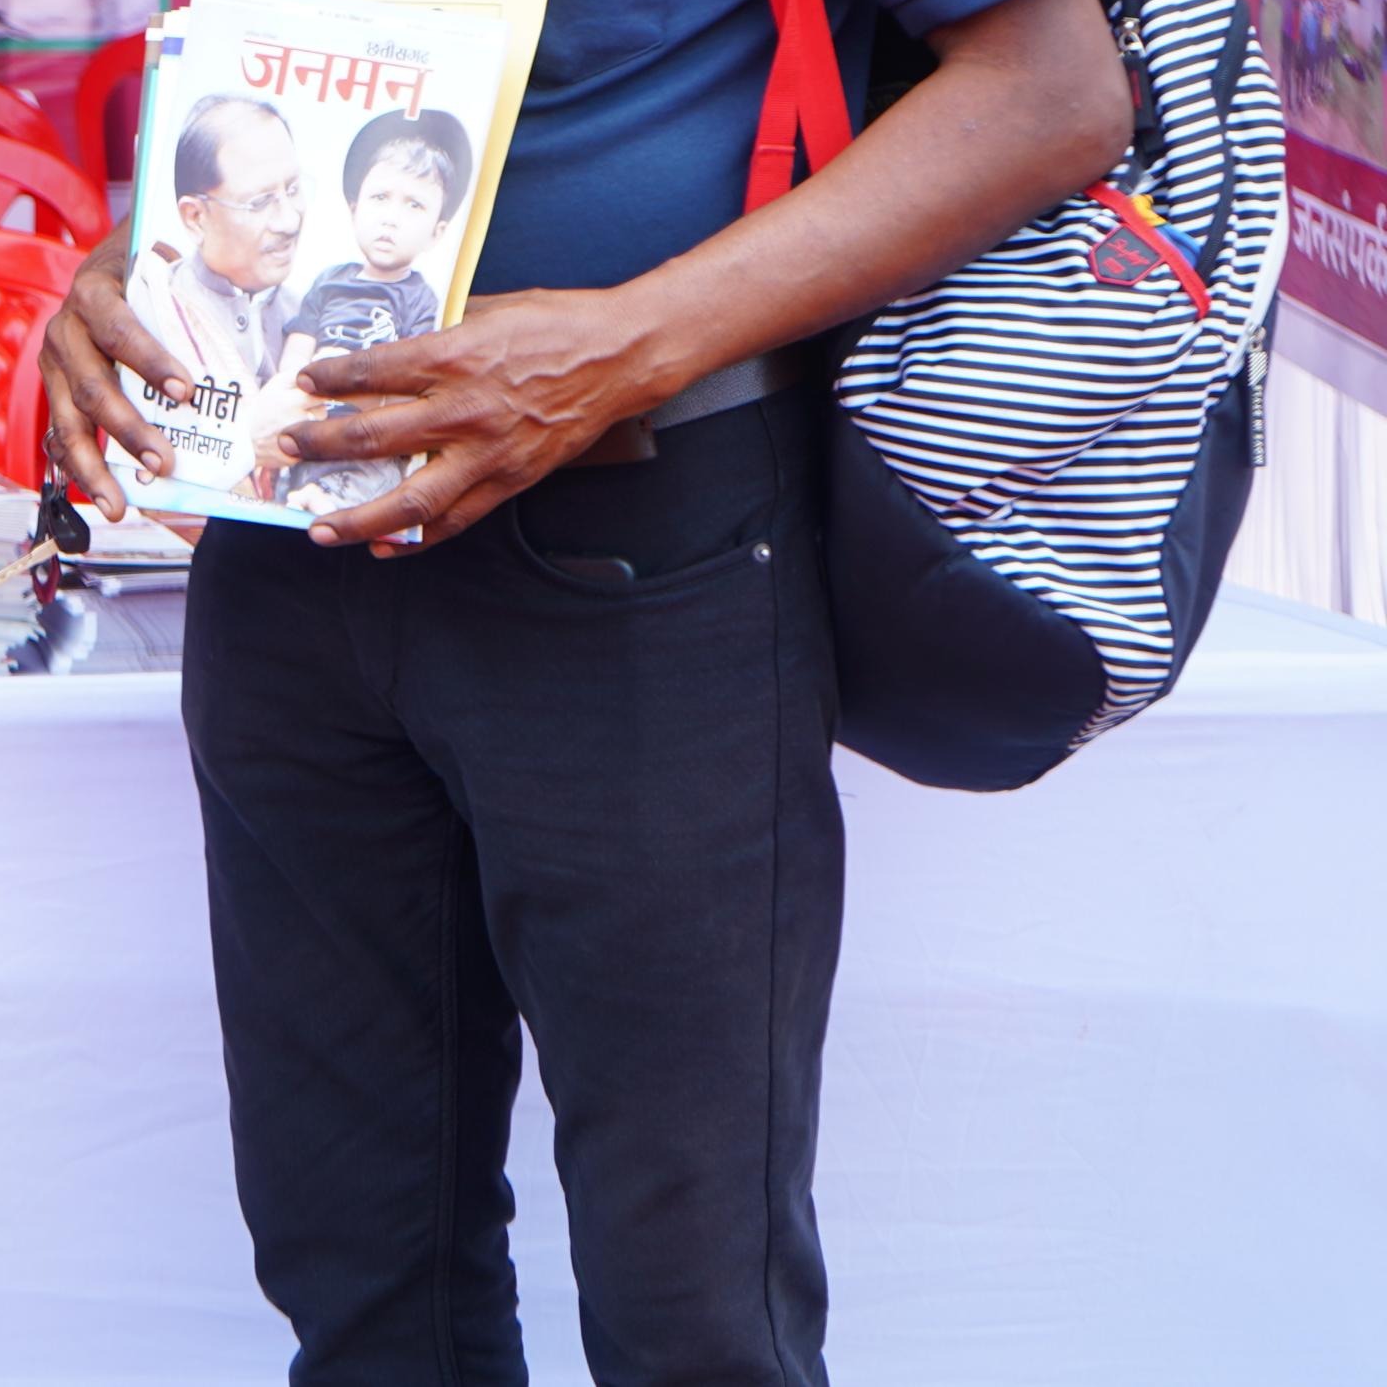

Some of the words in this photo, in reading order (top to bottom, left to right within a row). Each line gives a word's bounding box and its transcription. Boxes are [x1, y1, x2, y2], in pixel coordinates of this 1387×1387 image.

[241, 39, 433, 118] जनमन
[190, 375, 243, 429] पीढ़ी
[169, 425, 234, 466] छत्तीसगढ़
